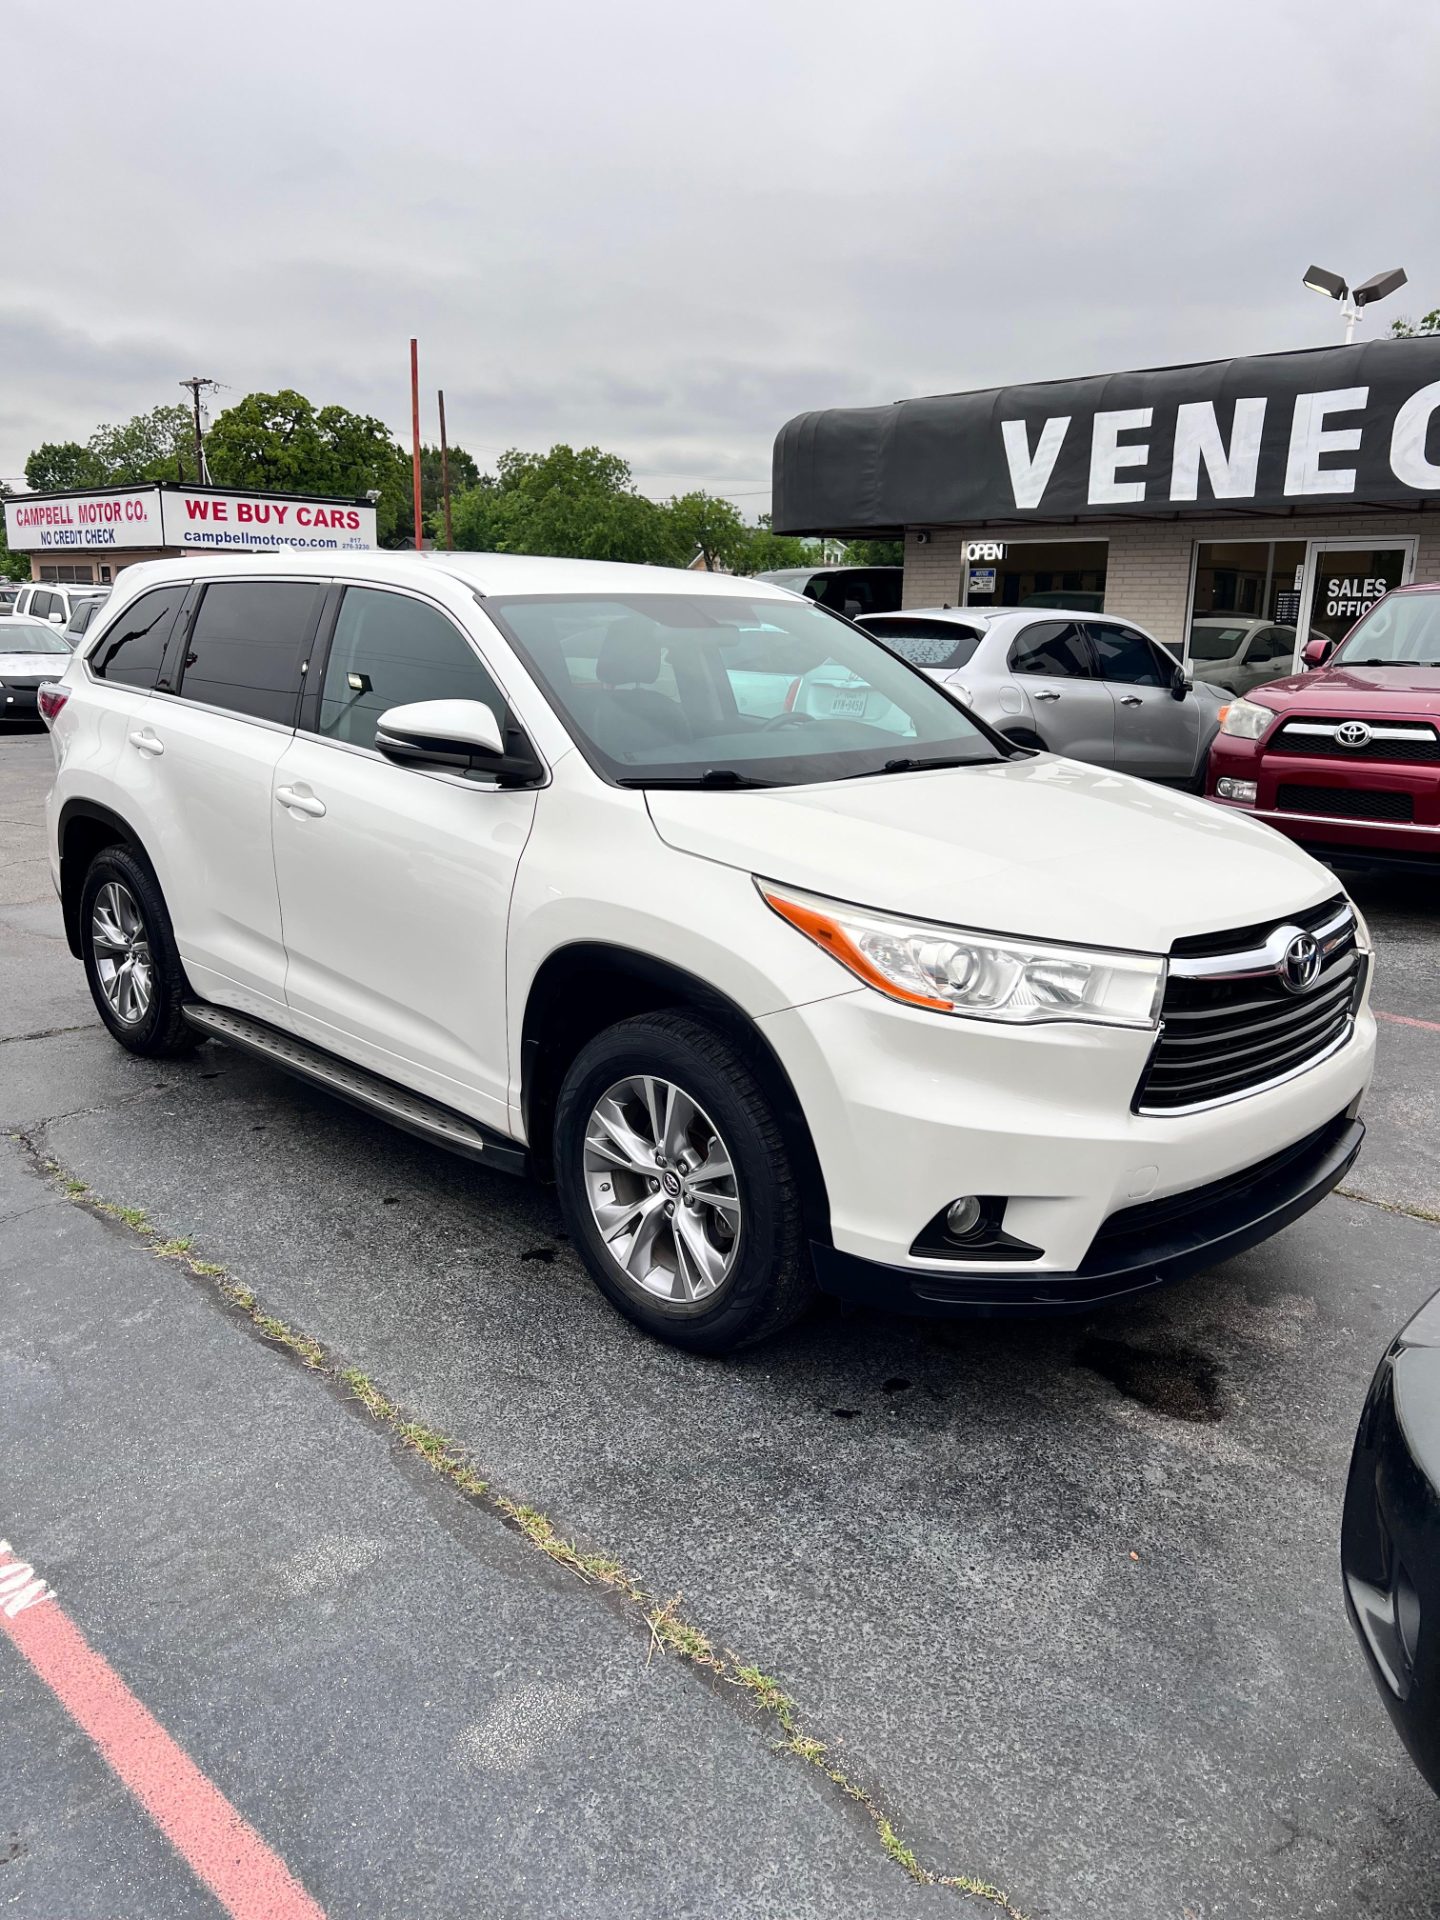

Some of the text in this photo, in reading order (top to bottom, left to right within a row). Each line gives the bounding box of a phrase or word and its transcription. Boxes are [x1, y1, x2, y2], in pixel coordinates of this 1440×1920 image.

[16, 500, 148, 527] CAMPBELL MOTOR CO.
[185, 500, 361, 530] WE BUY CARS
[40, 528, 116, 546] NO CREDIT CHECK
[184, 531, 338, 549] campbellmotorco.com
[967, 543, 1004, 561] OPEN
[1327, 578, 1388, 598] SALES
[1326, 600, 1376, 617] OFFIC
